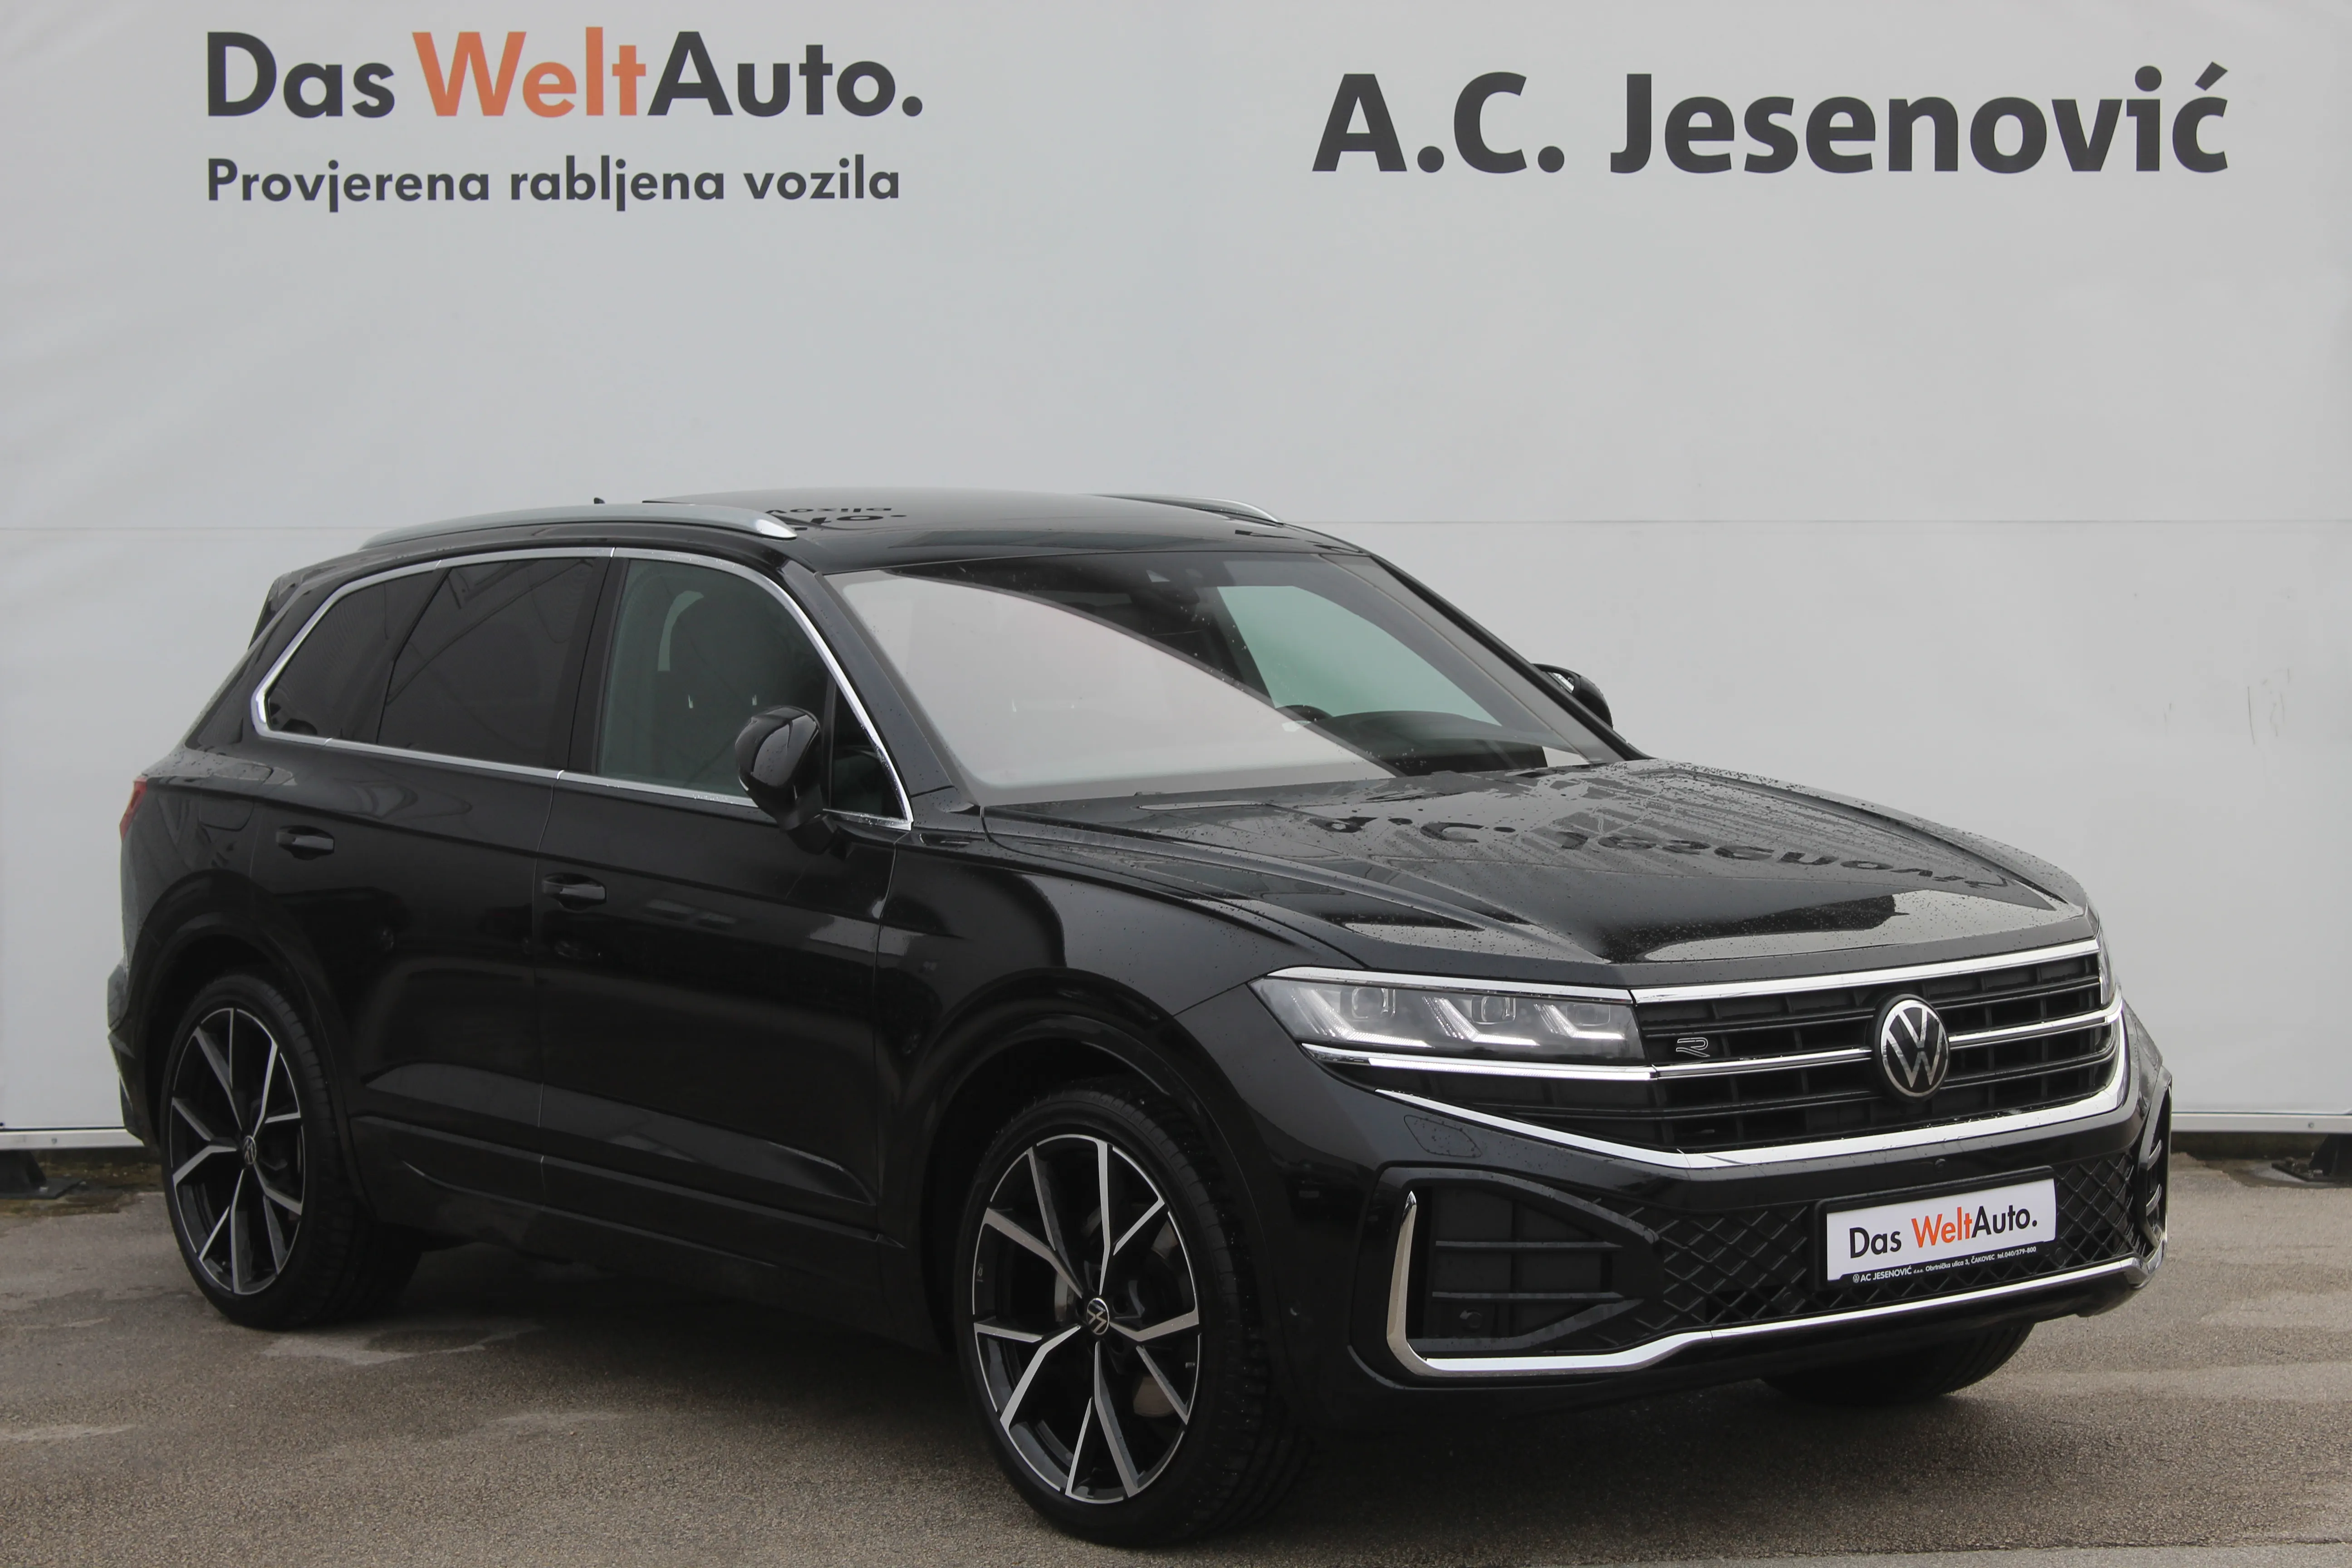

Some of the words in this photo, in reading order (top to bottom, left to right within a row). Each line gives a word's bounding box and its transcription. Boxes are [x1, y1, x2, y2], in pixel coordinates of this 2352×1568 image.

[207, 32, 395, 118] Das
[412, 27, 923, 117] WeltAuto.
[1312, 72, 1565, 173] A.C.
[1611, 62, 2228, 173] Jesenović
[209, 159, 489, 212] Provjerena
[511, 155, 724, 211] rabljena
[743, 154, 899, 201] vozila
[1850, 1227, 1902, 1258] Das
[1911, 1205, 2038, 1248] WeltAuto.
[1860, 1273, 1872, 1283] AC
[1873, 1265, 1912, 1280] JESENOVIĆ
[1926, 1261, 1950, 1272] Obrtnička
[1971, 1254, 1995, 1264] ČAKOVEC
